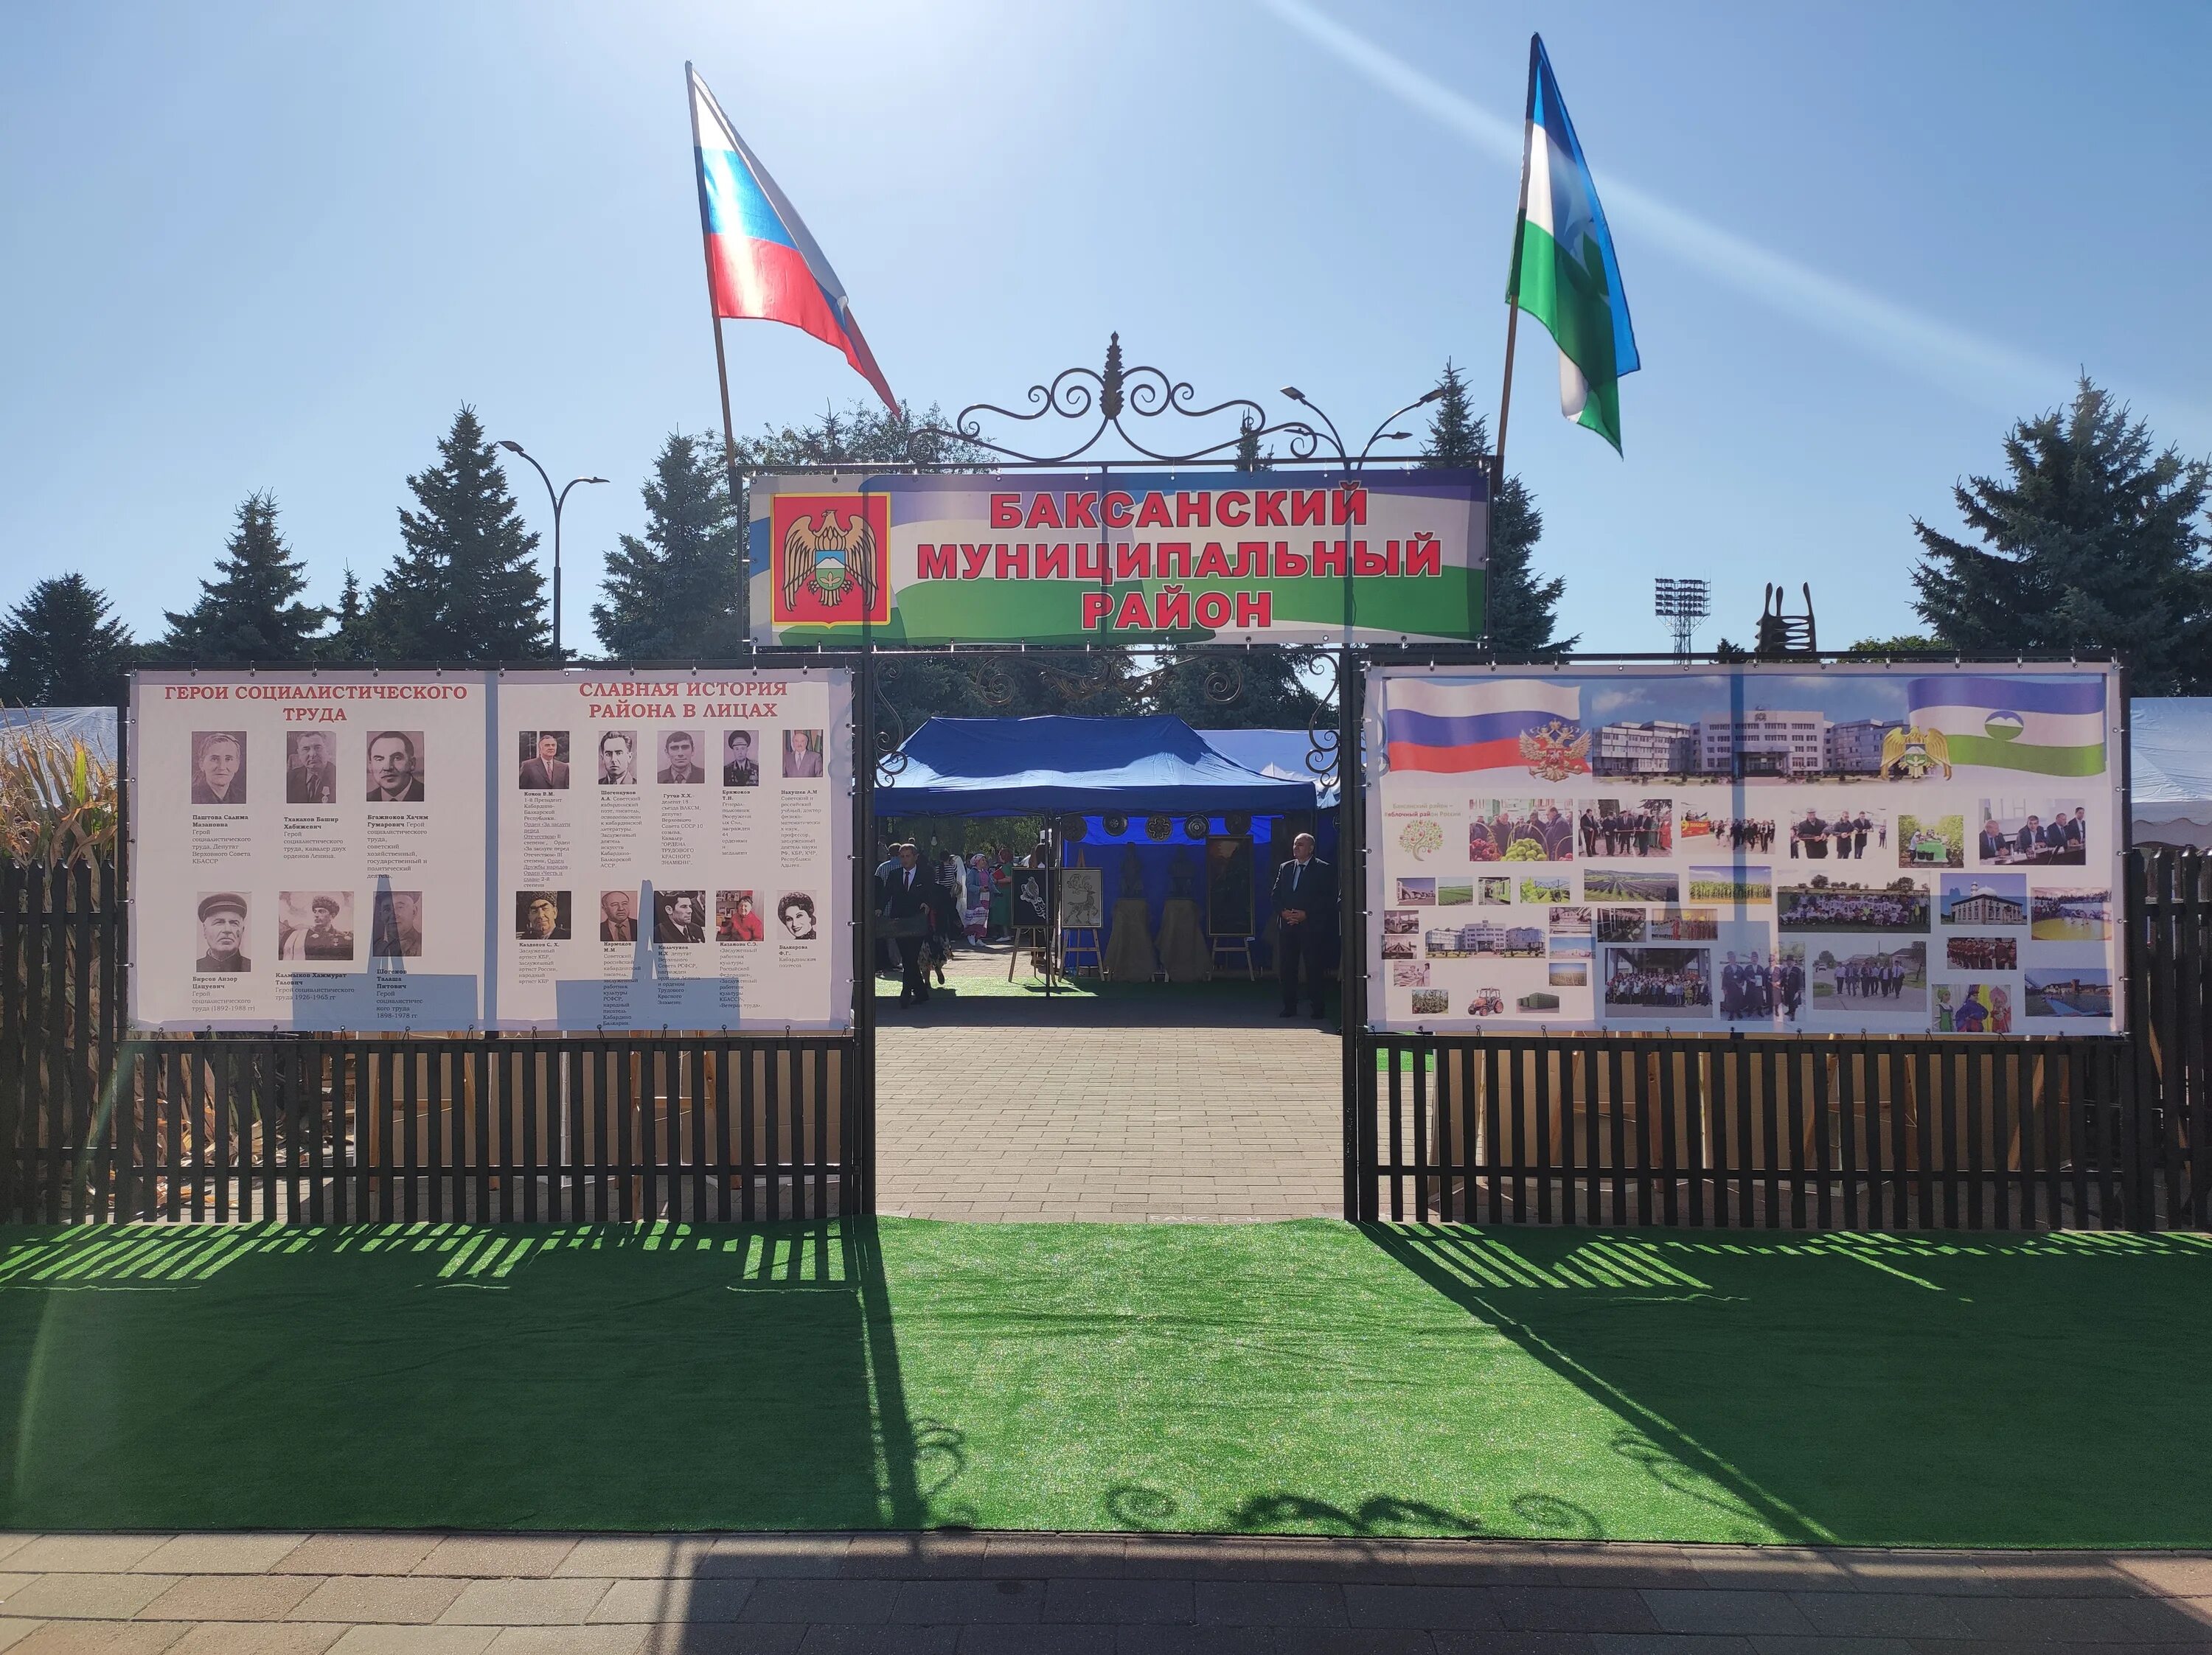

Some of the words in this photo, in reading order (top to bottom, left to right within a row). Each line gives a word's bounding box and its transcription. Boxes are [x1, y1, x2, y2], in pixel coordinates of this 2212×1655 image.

[988, 481, 1369, 530] БАКСАНСКИЙ
[915, 532, 1443, 587] МУНИЦИПАЛЬНЫЙ
[1081, 585, 1273, 630] РАЙОН
[164, 686, 229, 701] ГЕРОИ
[234, 686, 468, 701] СОЦИАЛИСТИЧЕСКОГО
[580, 682, 679, 697] СЛАВНАЯ
[686, 681, 788, 696] ИСТОРИЯ
[283, 708, 347, 723] ТРУДА
[589, 700, 676, 718] РАЙОНА
[683, 704, 697, 718] В
[703, 703, 779, 720] ЛИЦАХ
